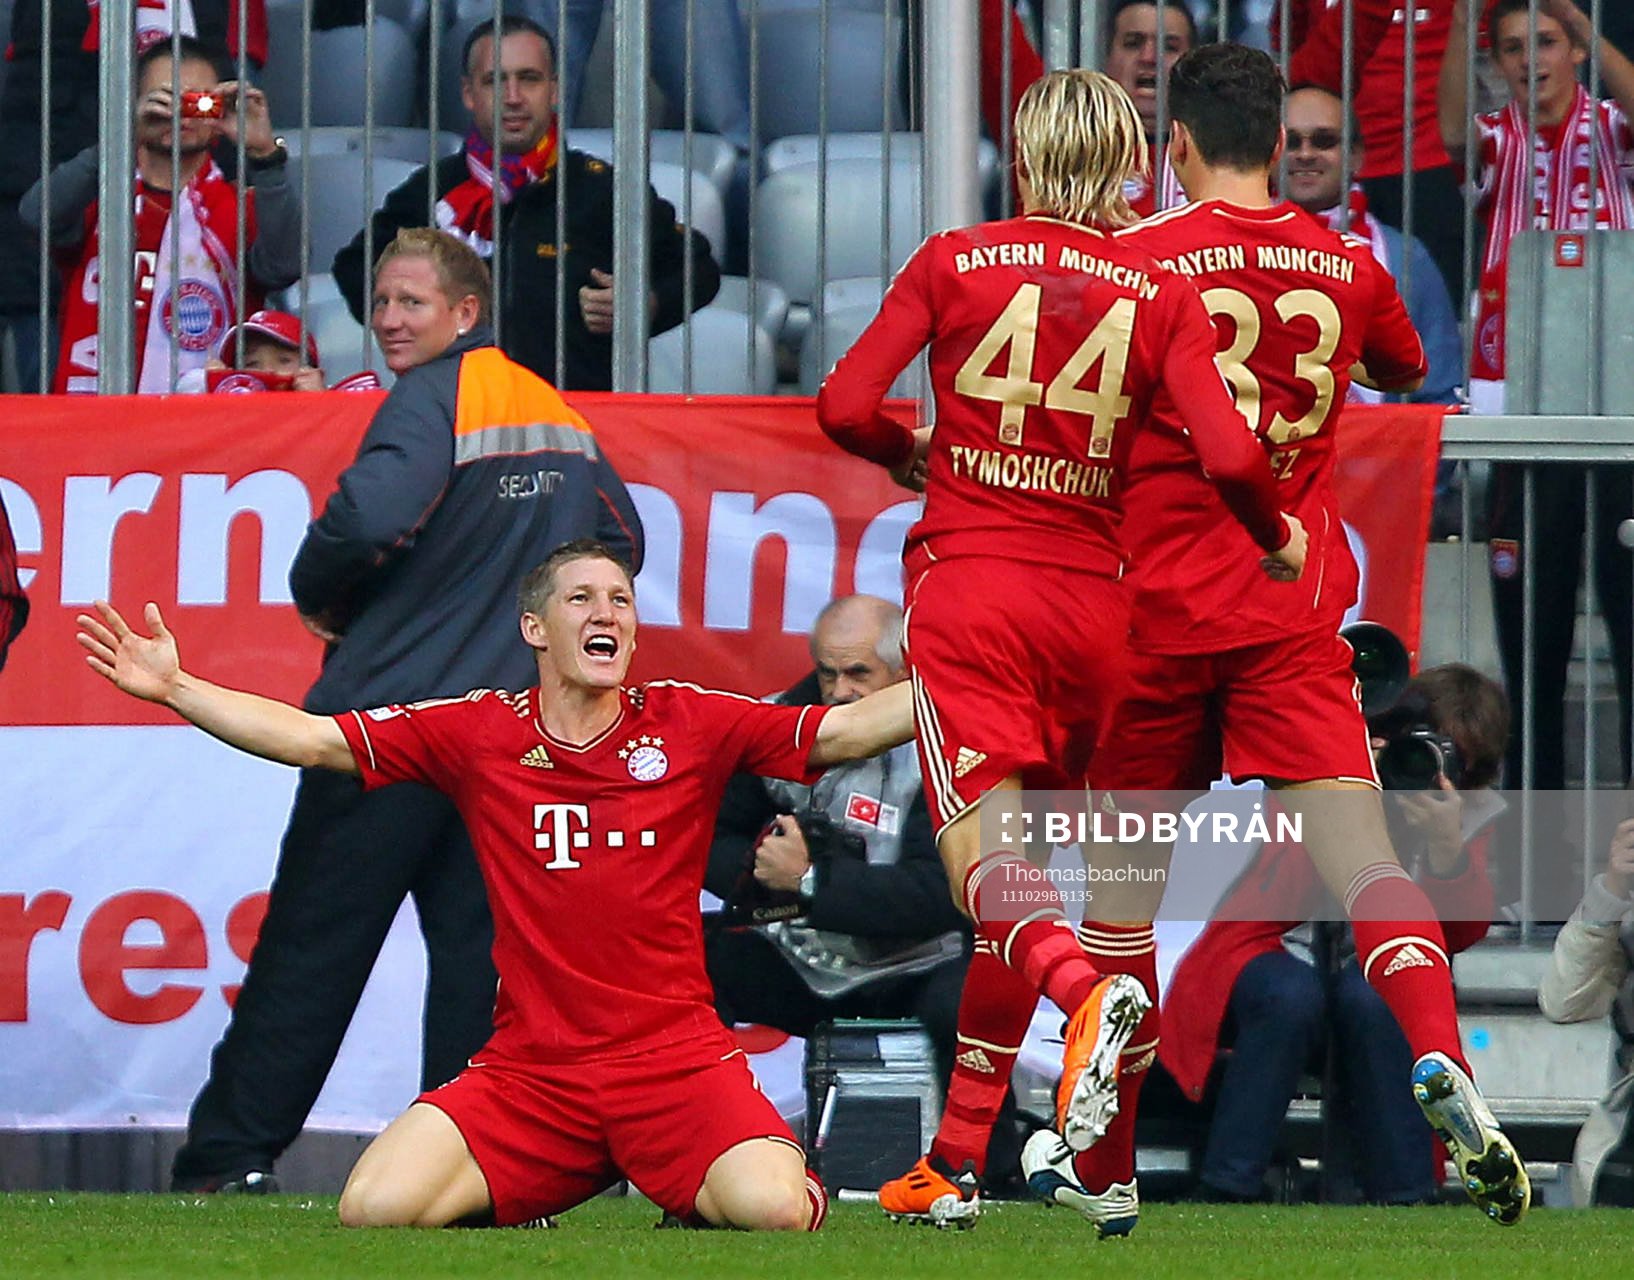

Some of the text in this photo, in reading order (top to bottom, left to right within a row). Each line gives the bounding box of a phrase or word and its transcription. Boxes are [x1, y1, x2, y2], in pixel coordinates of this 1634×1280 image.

[955, 243, 1159, 300] BAYERN MÜNCHN
[1257, 246, 1354, 284] MÜNCHEN
[955, 283, 1137, 458] 44
[1200, 288, 1342, 444] 33
[498, 471, 565, 498] SECUIT
[950, 445, 1113, 497] TYMOSHCHUK
[752, 904, 799, 920] Canon
